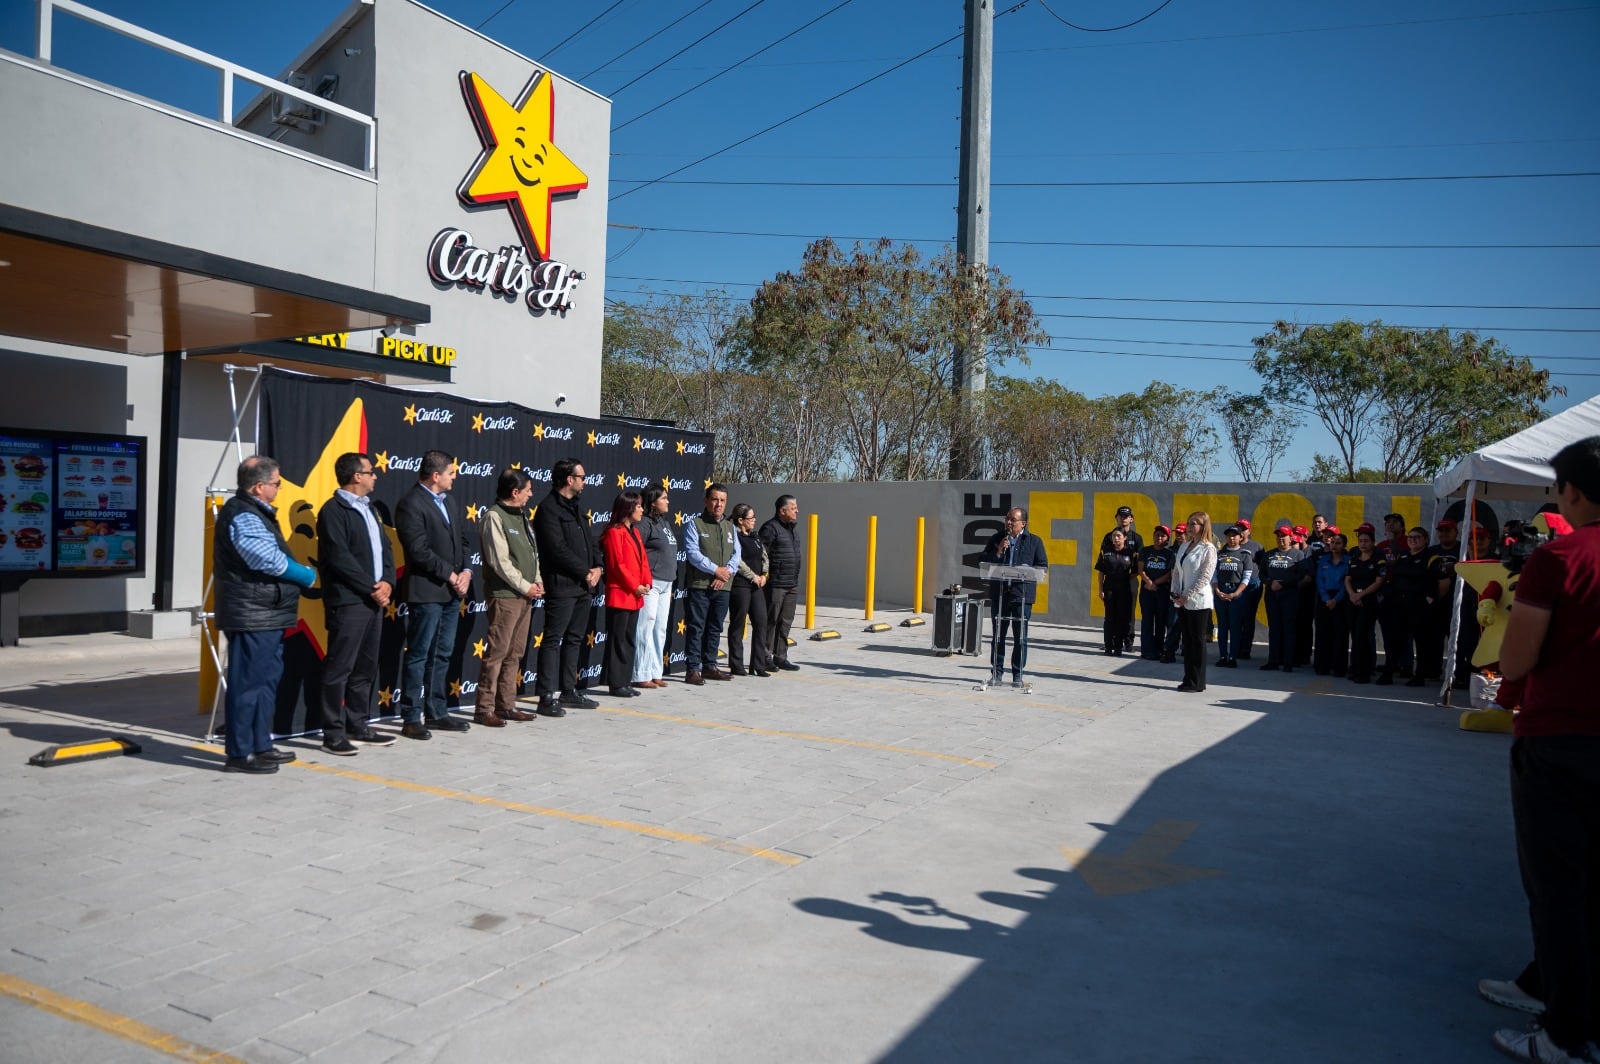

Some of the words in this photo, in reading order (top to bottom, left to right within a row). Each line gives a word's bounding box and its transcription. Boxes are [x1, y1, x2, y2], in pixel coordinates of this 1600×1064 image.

[437, 229, 530, 295] Carl's
[382, 337, 428, 362] PICK
[432, 345, 457, 366] UP
[415, 407, 440, 422] Carl's
[483, 416, 505, 430] Carl's
[388, 455, 415, 470] Carl's
